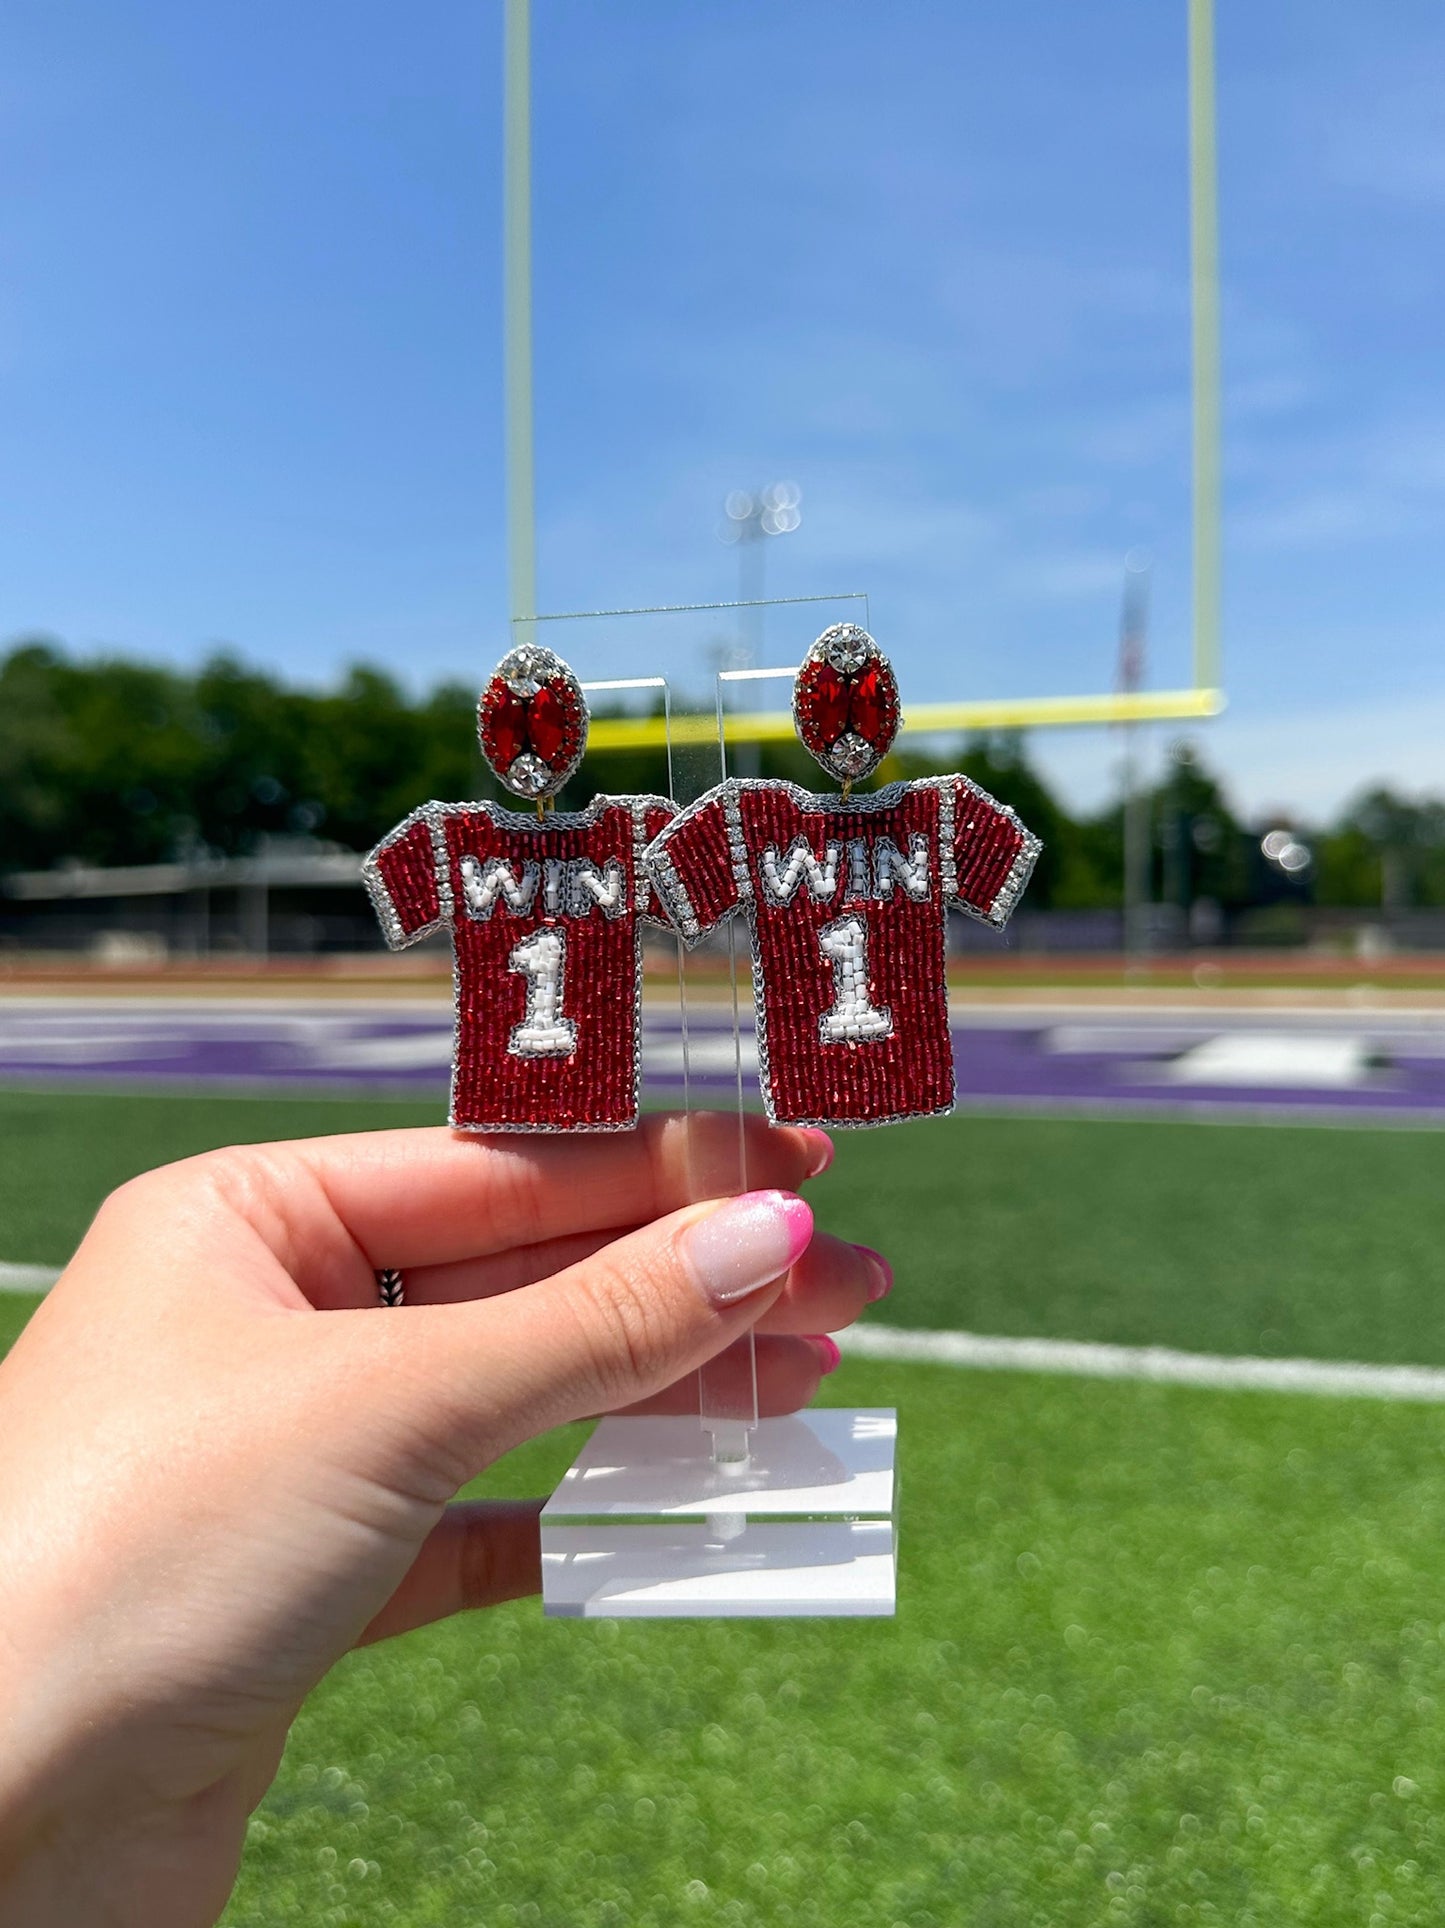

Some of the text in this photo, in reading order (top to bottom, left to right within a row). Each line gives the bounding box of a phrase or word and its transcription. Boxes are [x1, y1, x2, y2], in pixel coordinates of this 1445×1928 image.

[460, 857, 626, 920] WIN
[758, 834, 931, 906] WIN
[508, 927, 579, 1058] 1
[818, 913, 892, 1043] 1
